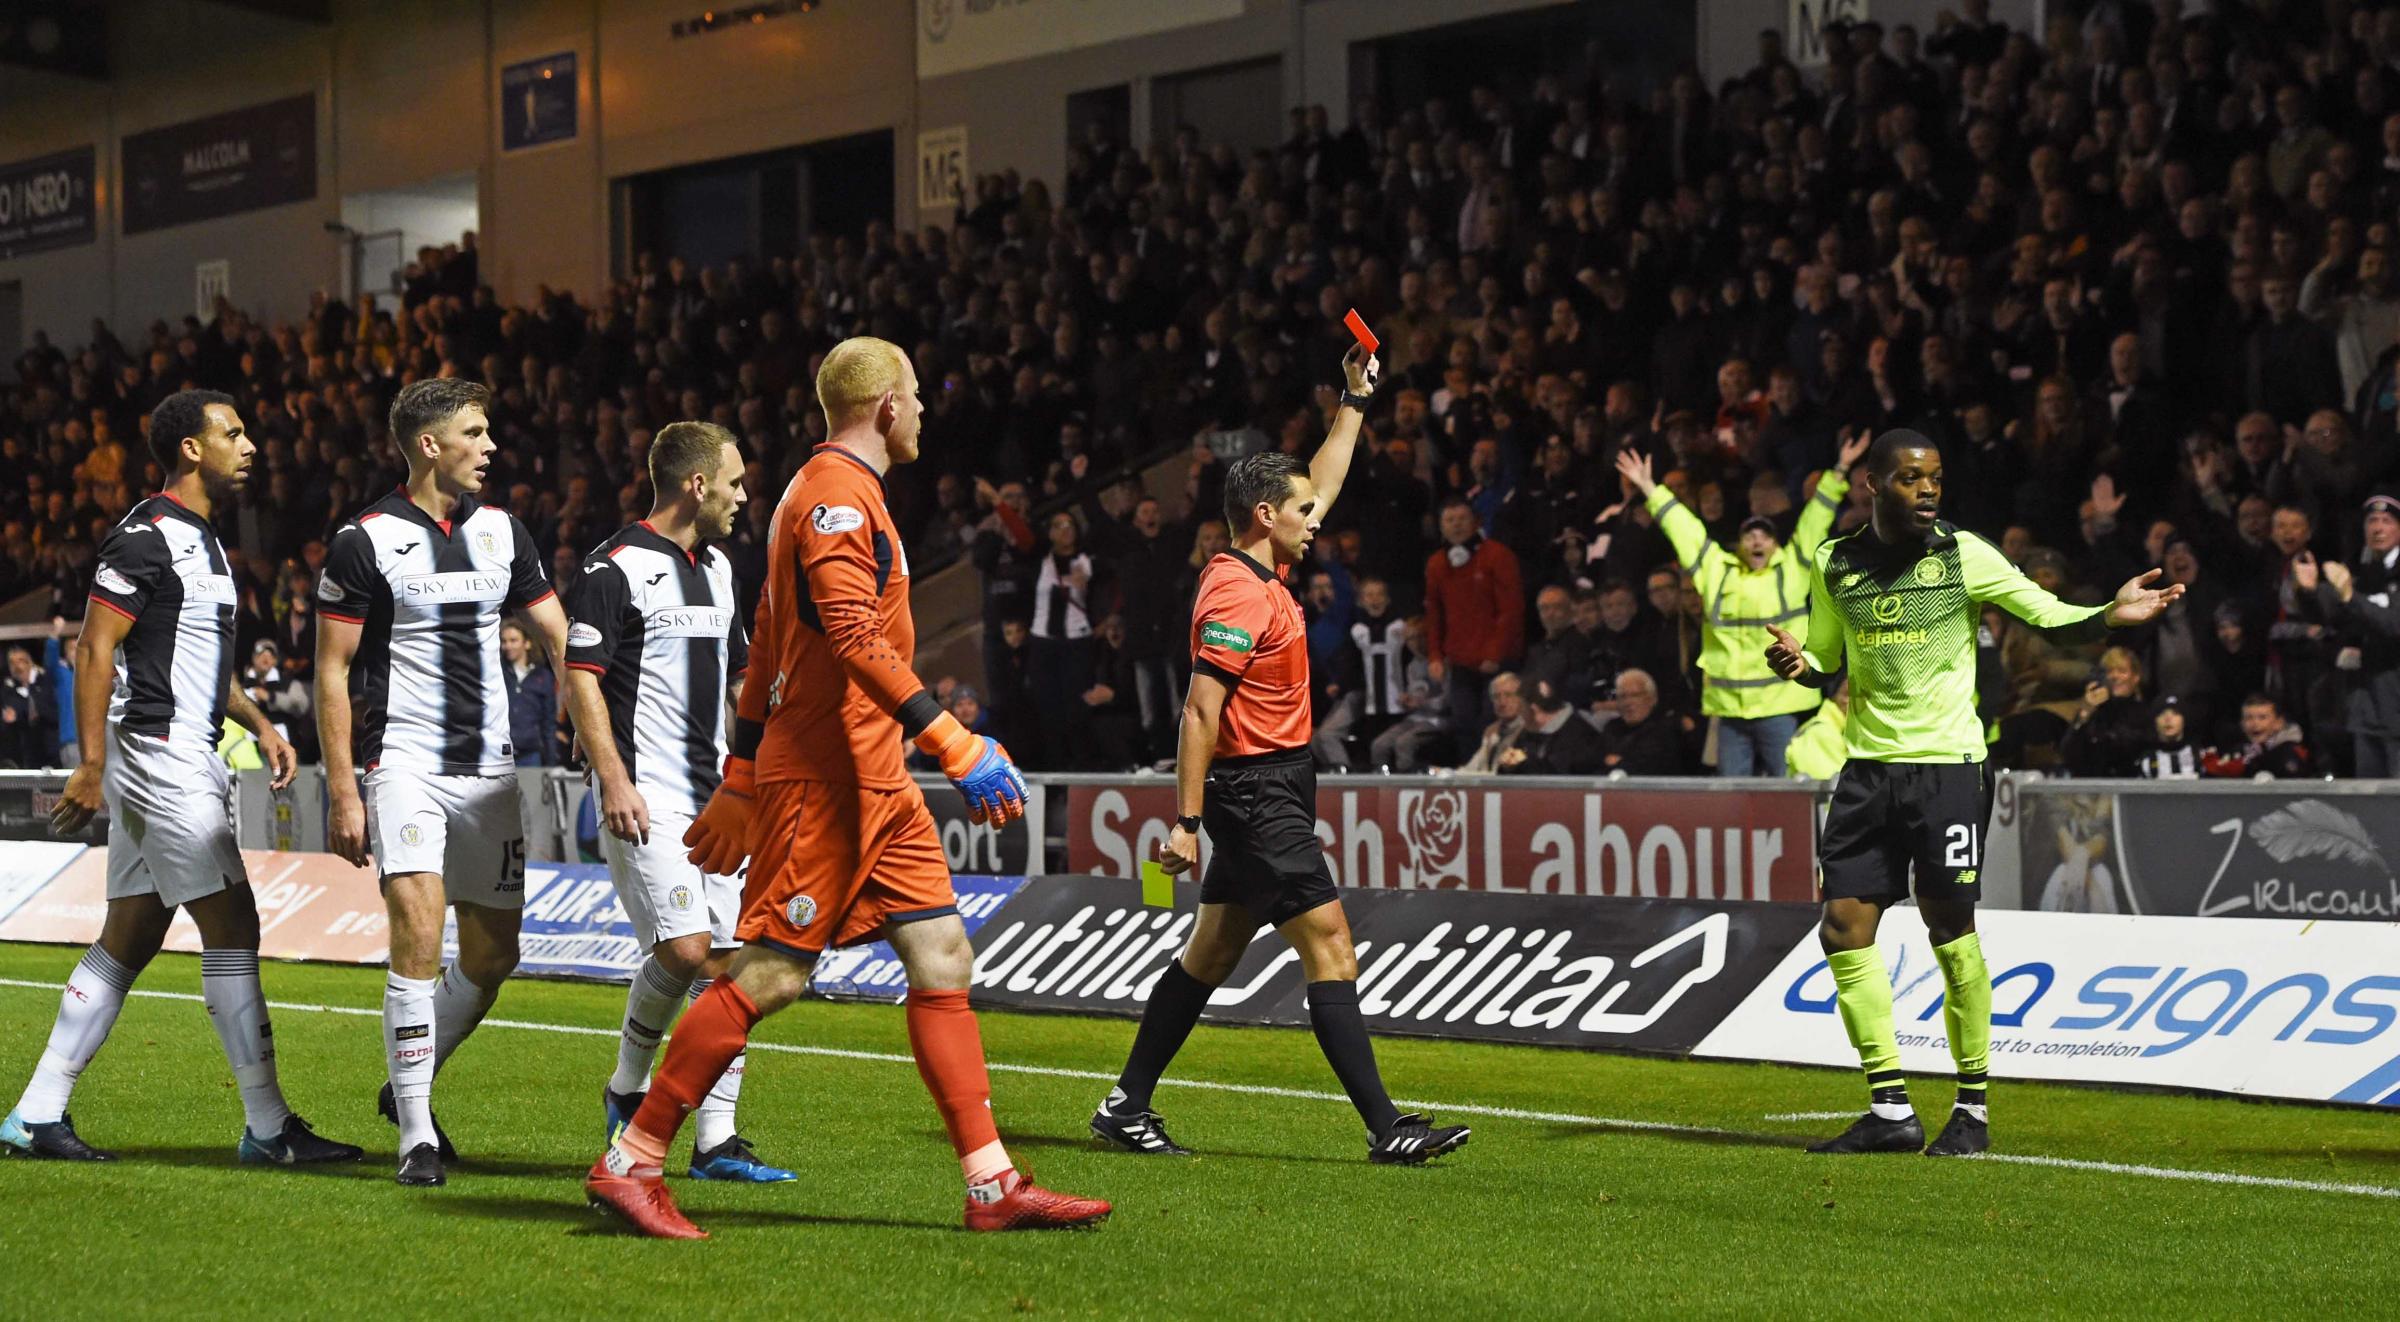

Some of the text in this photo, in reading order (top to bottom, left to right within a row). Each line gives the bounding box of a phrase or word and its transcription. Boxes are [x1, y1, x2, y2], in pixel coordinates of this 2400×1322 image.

[1856, 628, 1928, 647] dafabet
[1484, 790, 1784, 901] Labour
[1945, 822, 1978, 867] 21
[2009, 1039, 2029, 1053] to
[2033, 1040, 2142, 1058] completion
